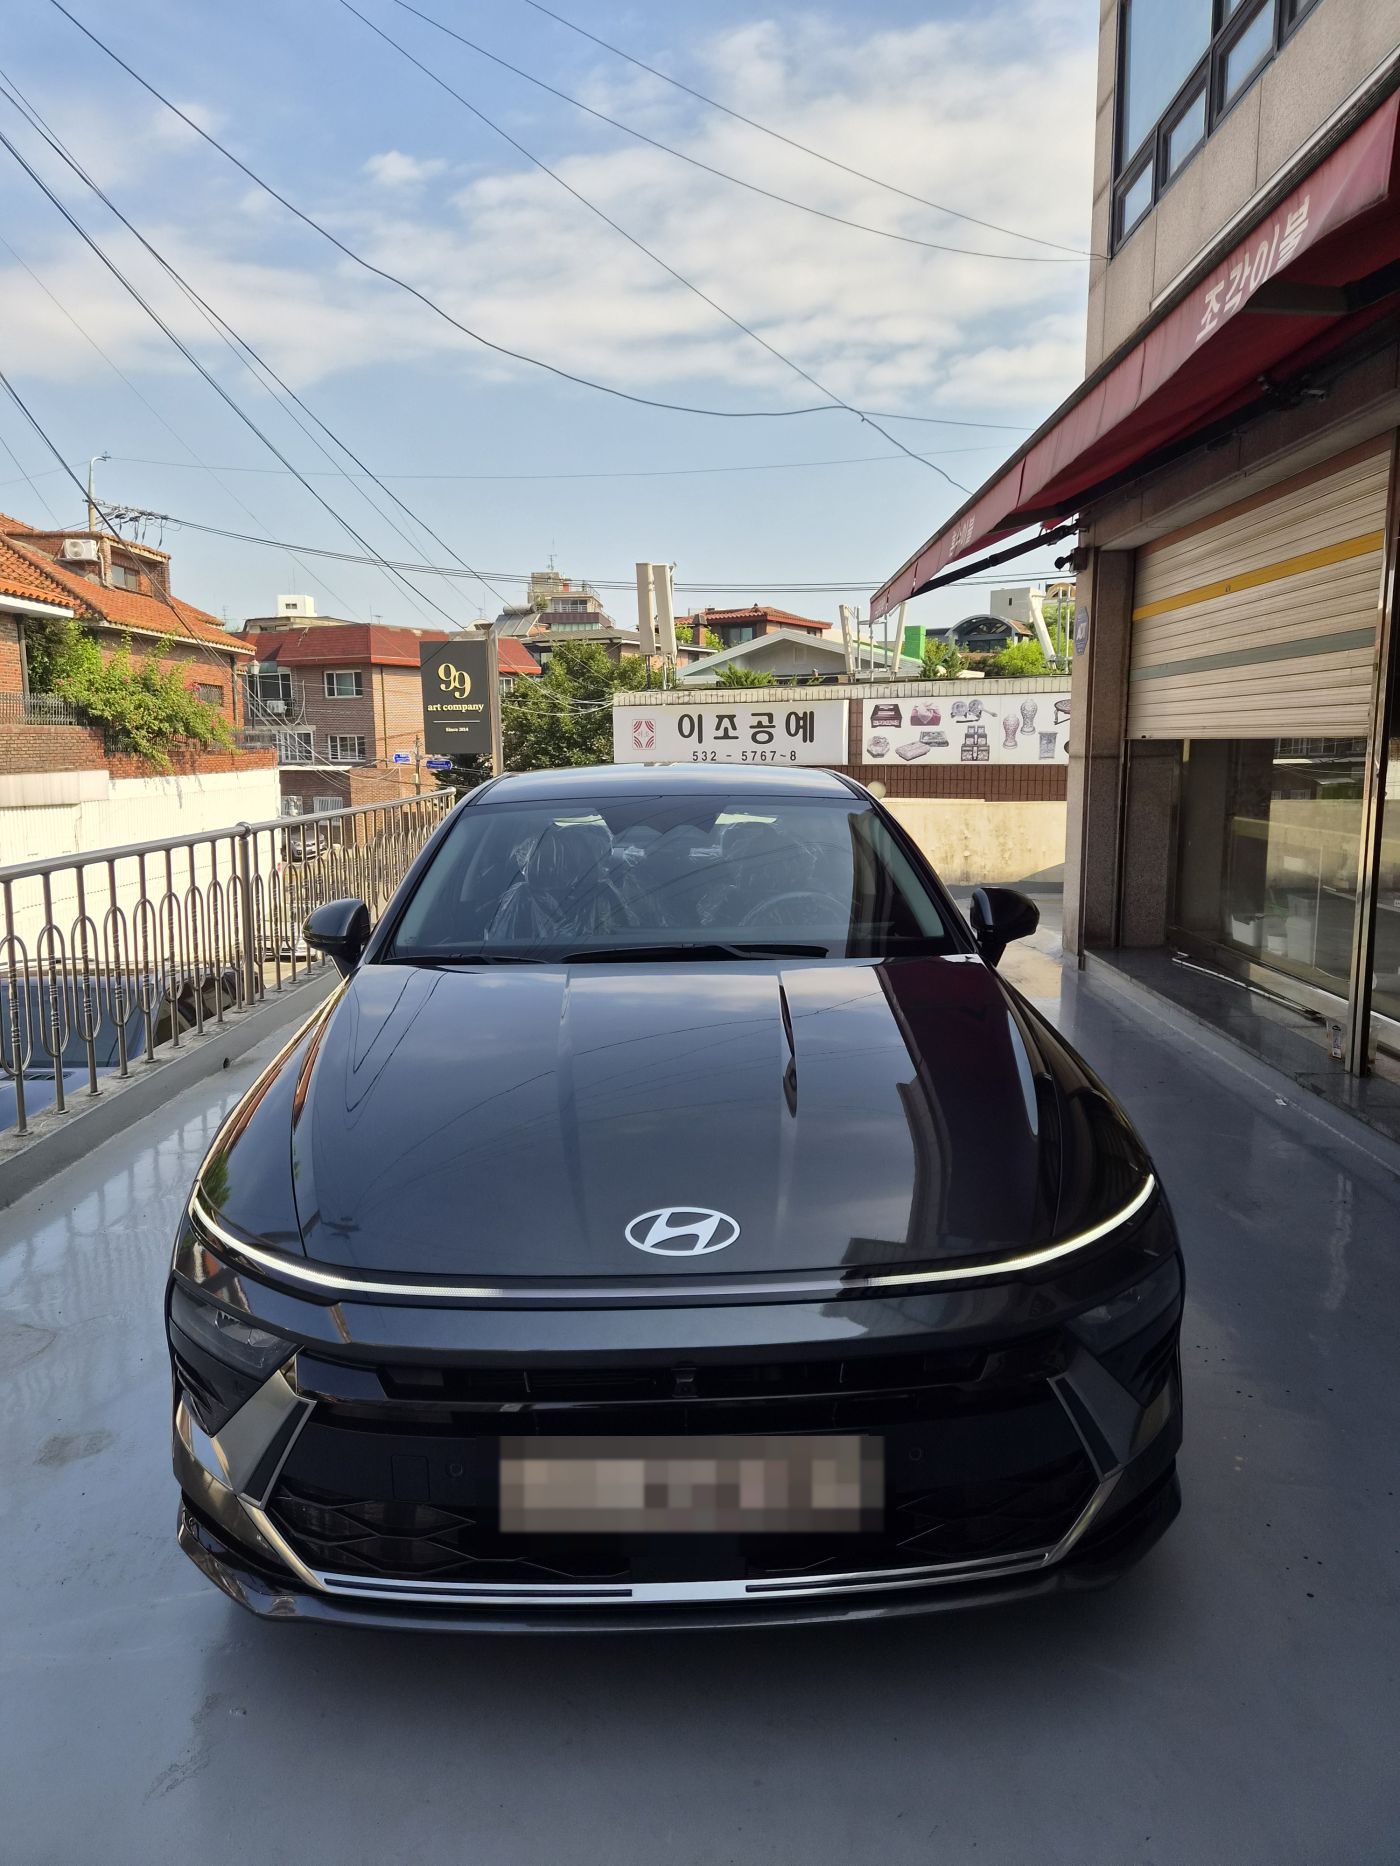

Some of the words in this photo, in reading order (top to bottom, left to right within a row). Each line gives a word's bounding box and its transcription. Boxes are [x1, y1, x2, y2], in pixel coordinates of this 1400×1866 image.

[1195, 195, 1311, 343] 조각이불
[437, 662, 472, 699] 99
[427, 703, 442, 711] art
[442, 703, 485, 713] company
[677, 710, 815, 745] 이조공예
